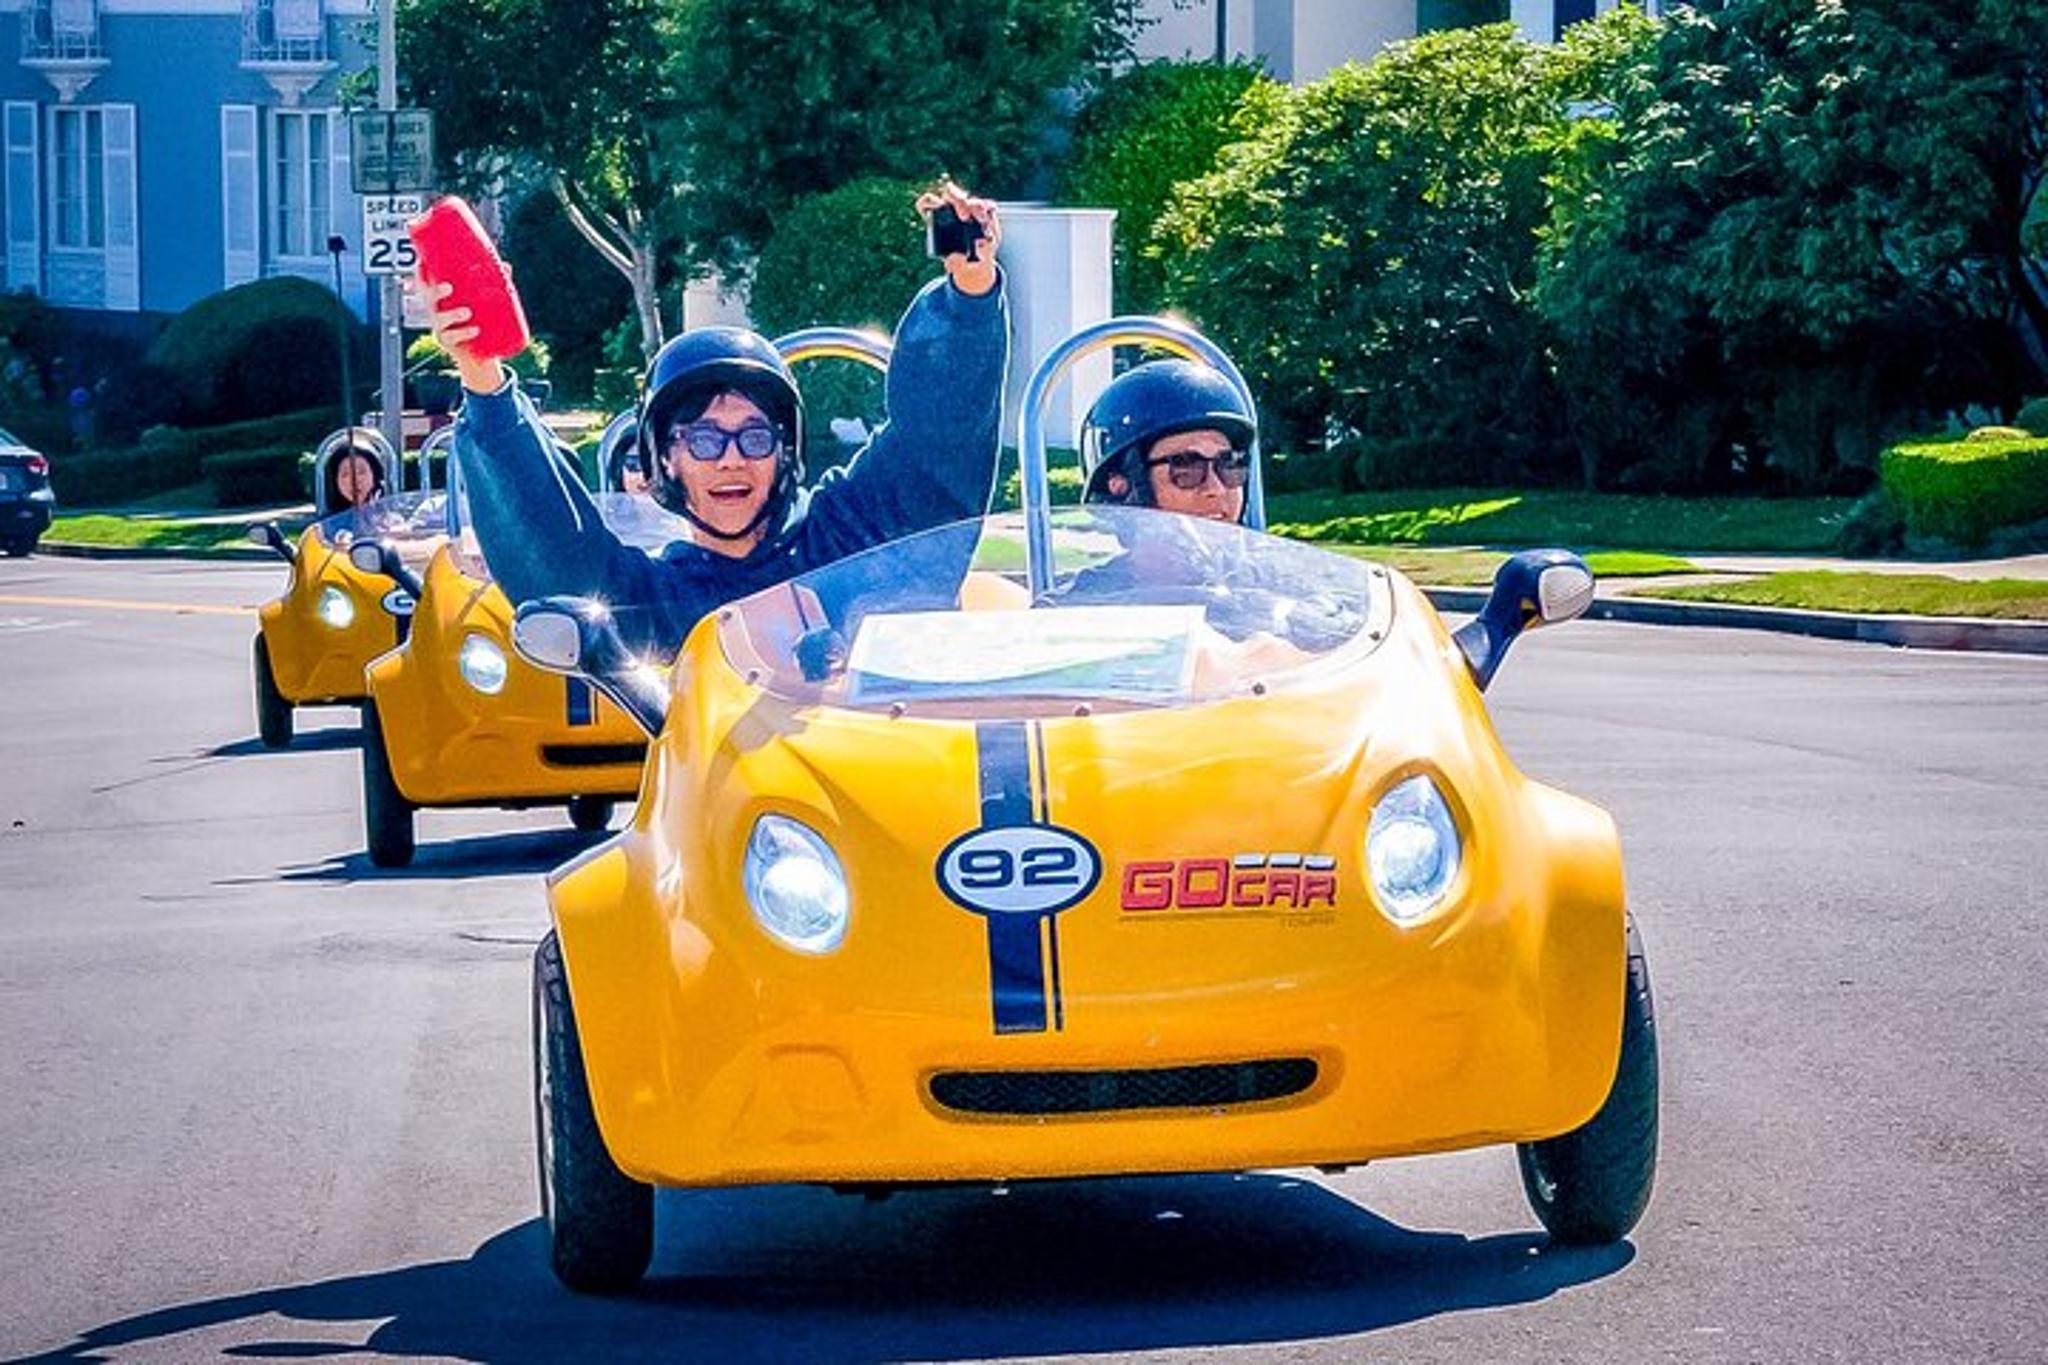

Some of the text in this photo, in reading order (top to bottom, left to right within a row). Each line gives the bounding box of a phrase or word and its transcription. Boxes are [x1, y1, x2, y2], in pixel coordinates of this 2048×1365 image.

[366, 200, 418, 214] SPEED
[372, 219, 408, 233] LIMI
[369, 237, 417, 268] 25
[958, 847, 1079, 888] 92
